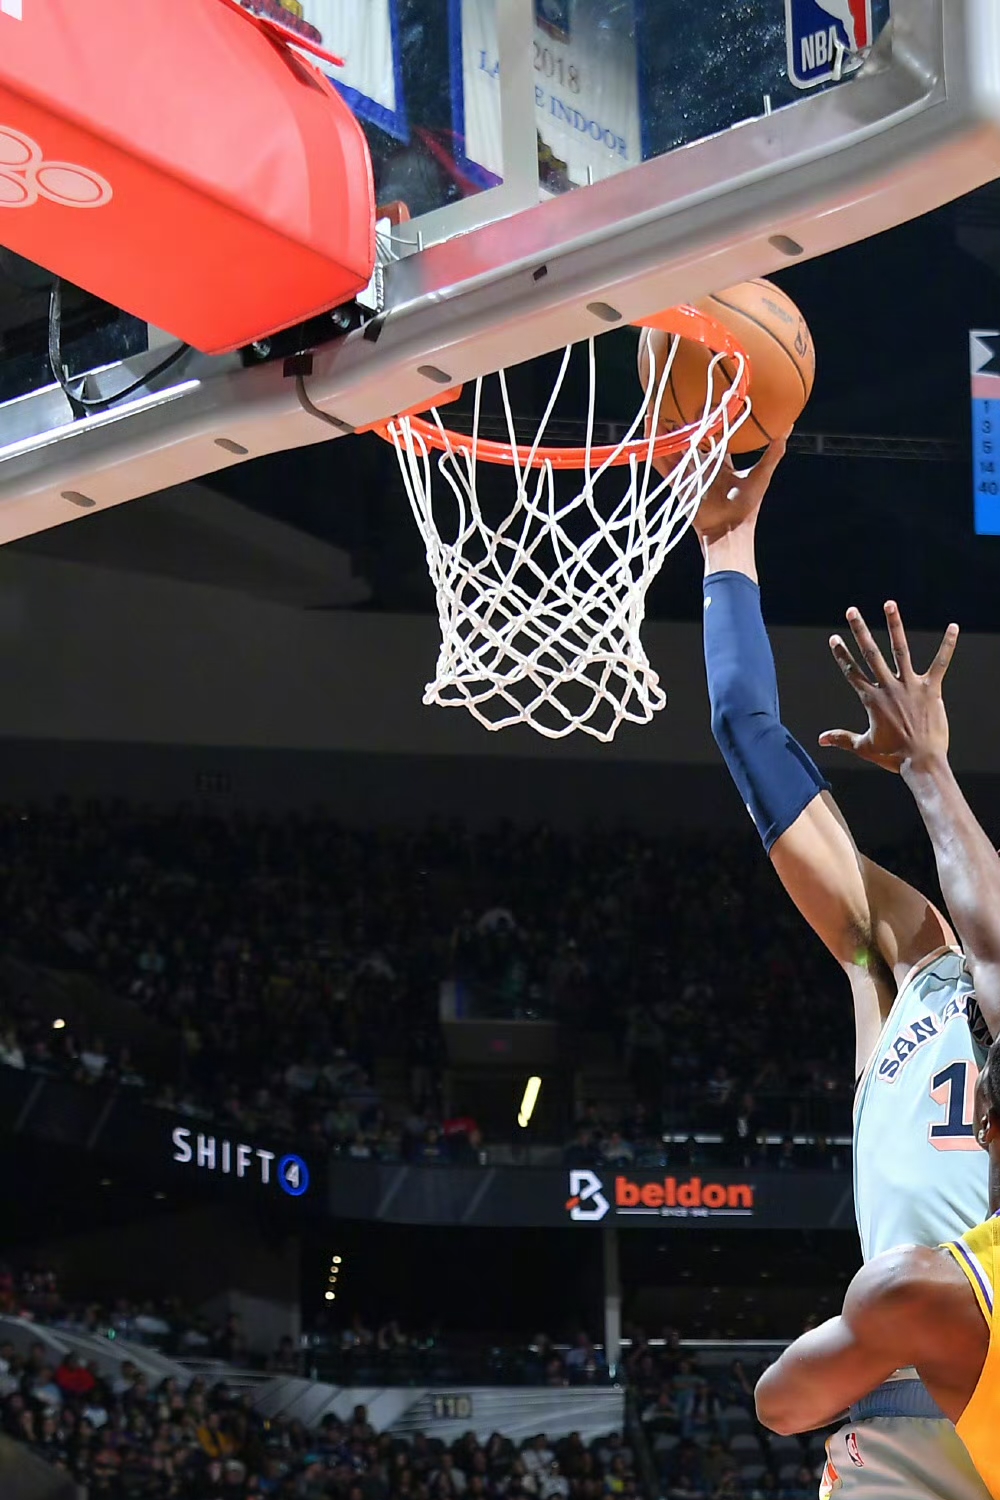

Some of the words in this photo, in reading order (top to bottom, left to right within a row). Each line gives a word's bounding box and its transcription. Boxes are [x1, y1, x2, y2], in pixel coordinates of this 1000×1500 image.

[801, 25, 838, 73] NBA
[550, 96, 628, 160] INDOOR
[980, 482, 998, 495] 40
[878, 1014, 940, 1080] SAN
[931, 1062, 977, 1138] 1
[615, 1176, 754, 1207] beldon
